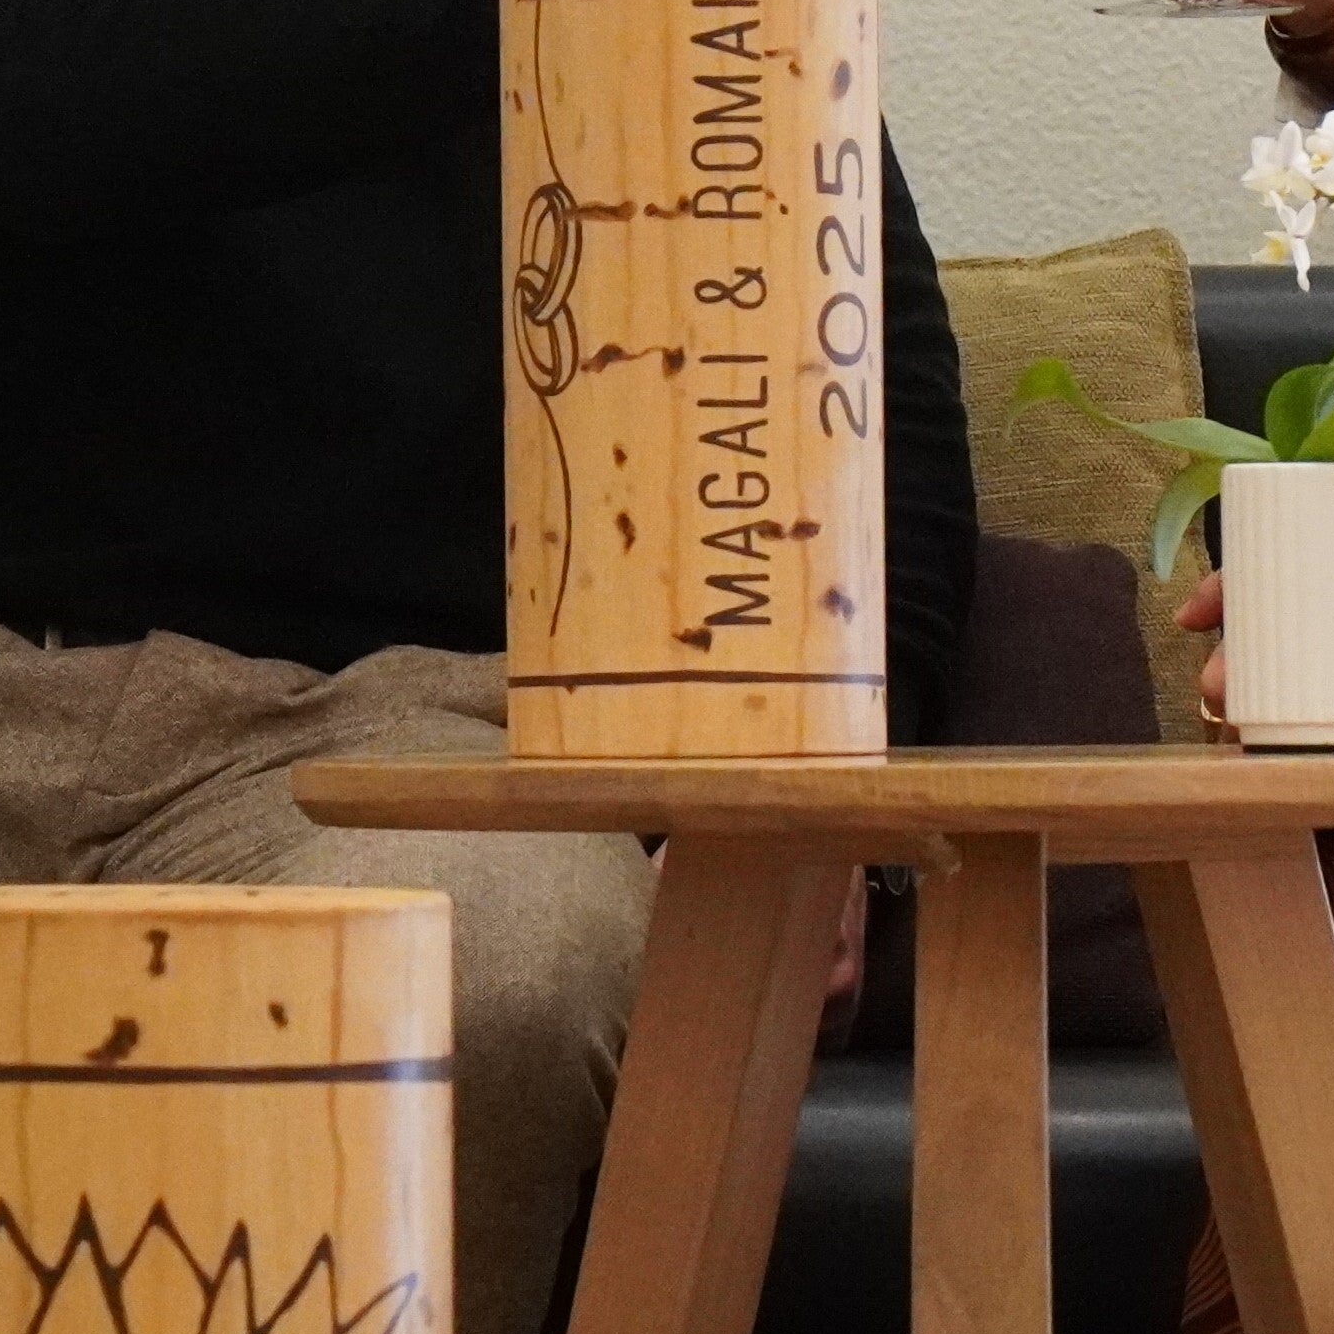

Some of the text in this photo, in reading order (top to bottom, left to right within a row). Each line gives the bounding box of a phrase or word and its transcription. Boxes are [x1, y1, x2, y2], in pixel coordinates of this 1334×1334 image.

[693, 266, 768, 310] &
[813, 138, 868, 440] 2025
[697, 354, 772, 627] MAGALI
